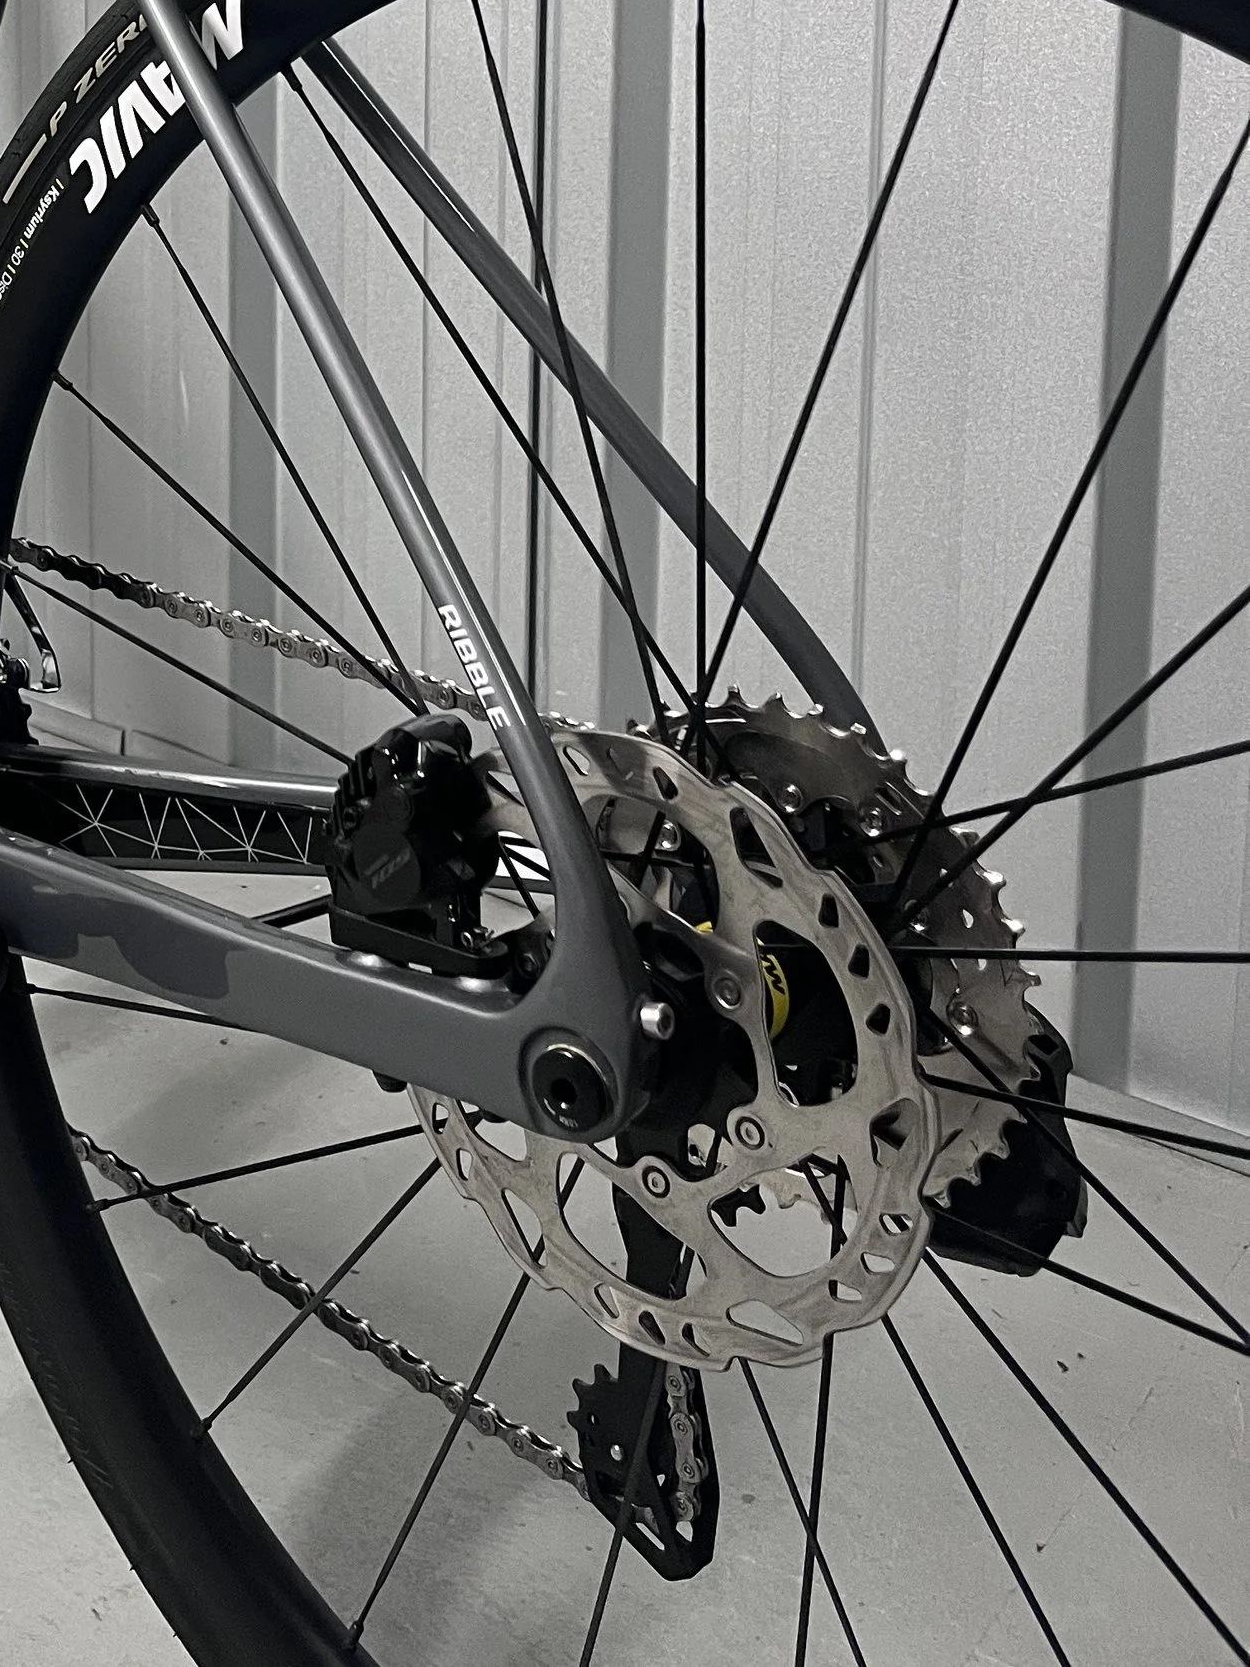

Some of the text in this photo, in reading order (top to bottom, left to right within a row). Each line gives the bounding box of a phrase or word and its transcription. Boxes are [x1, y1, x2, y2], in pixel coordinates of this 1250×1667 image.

[49, 101, 67, 137] P
[23, 185, 60, 239] Ksyrium
[11, 246, 25, 266] 30
[438, 603, 511, 732] RIBBLE
